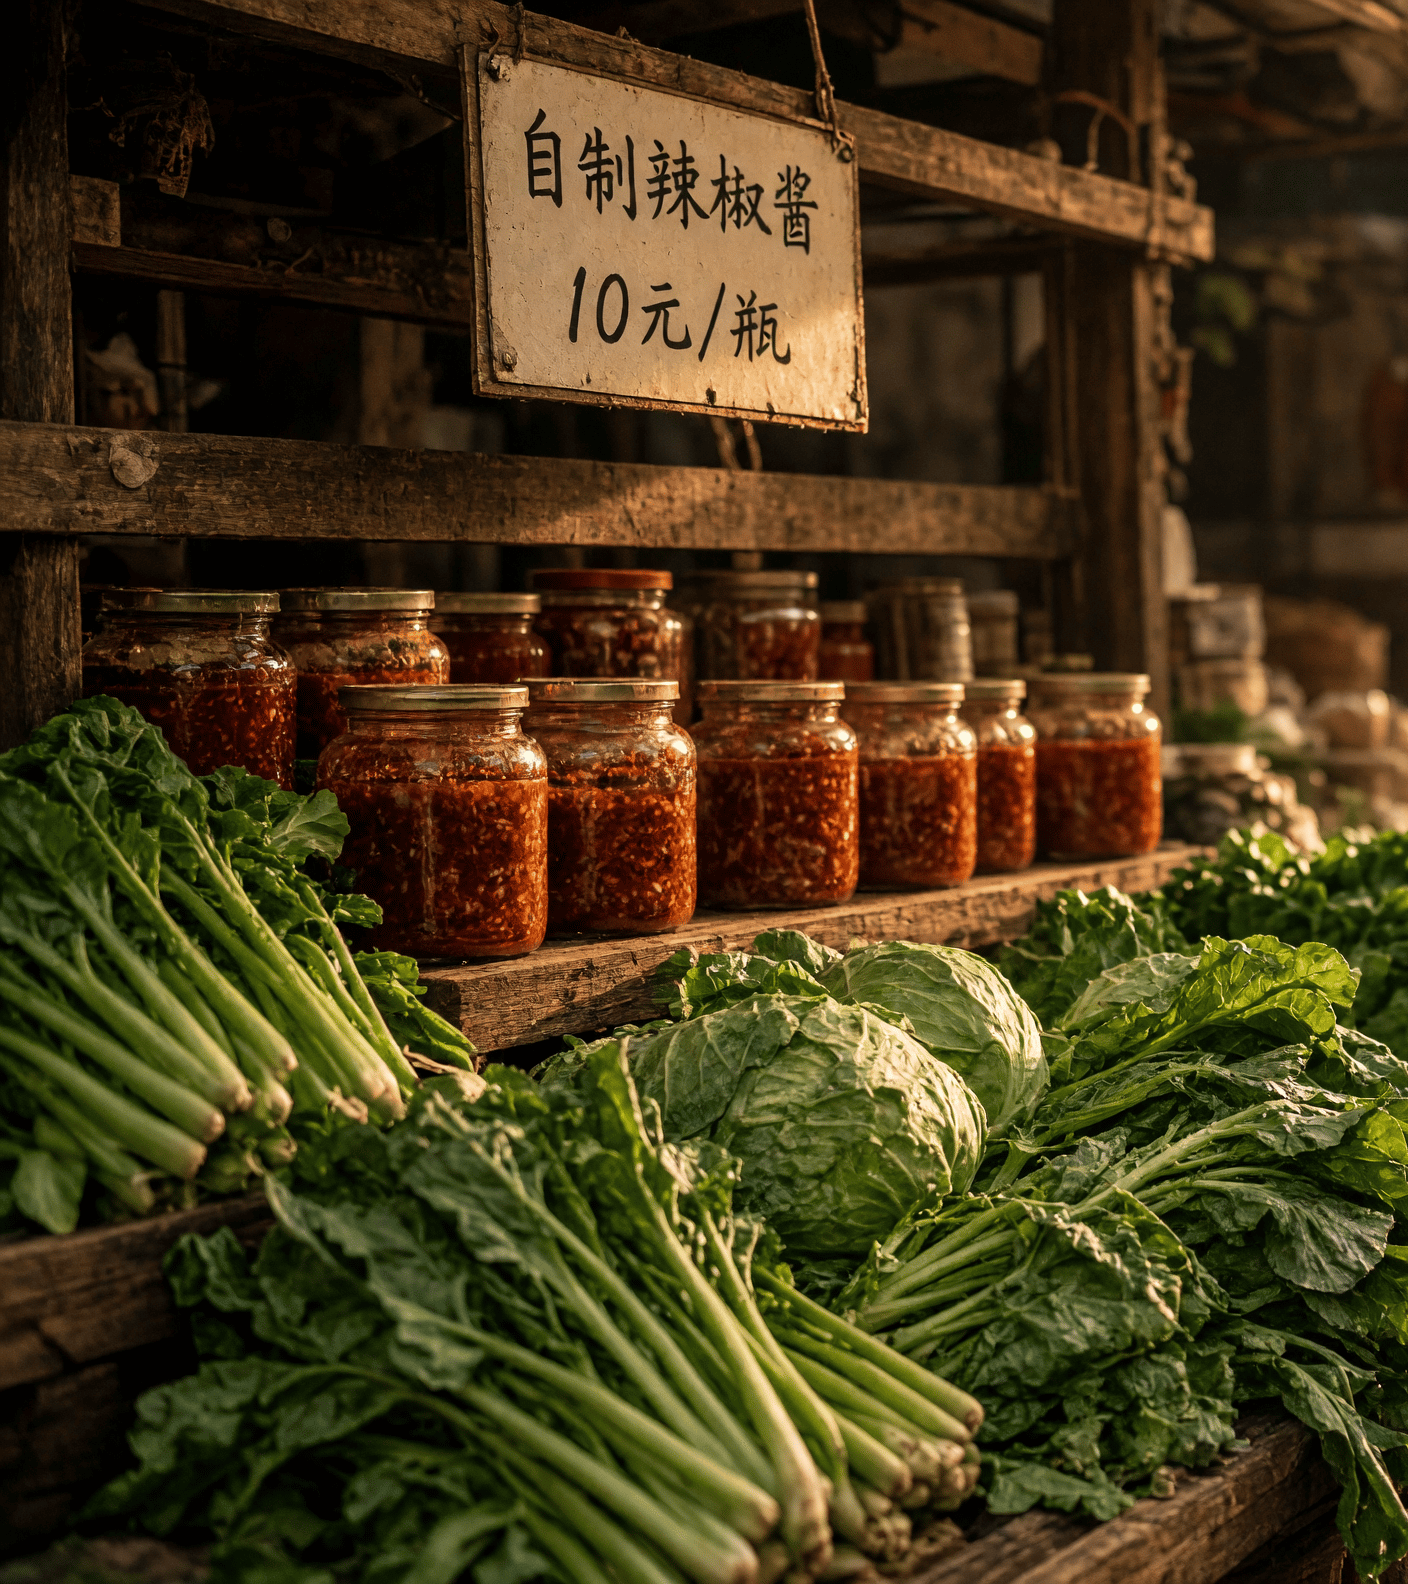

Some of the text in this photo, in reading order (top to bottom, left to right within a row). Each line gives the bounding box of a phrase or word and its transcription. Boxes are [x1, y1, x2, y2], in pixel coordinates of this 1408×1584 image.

[524, 108, 818, 255] 自制辣椒酱
[568, 266, 791, 365] 10元/瓶
